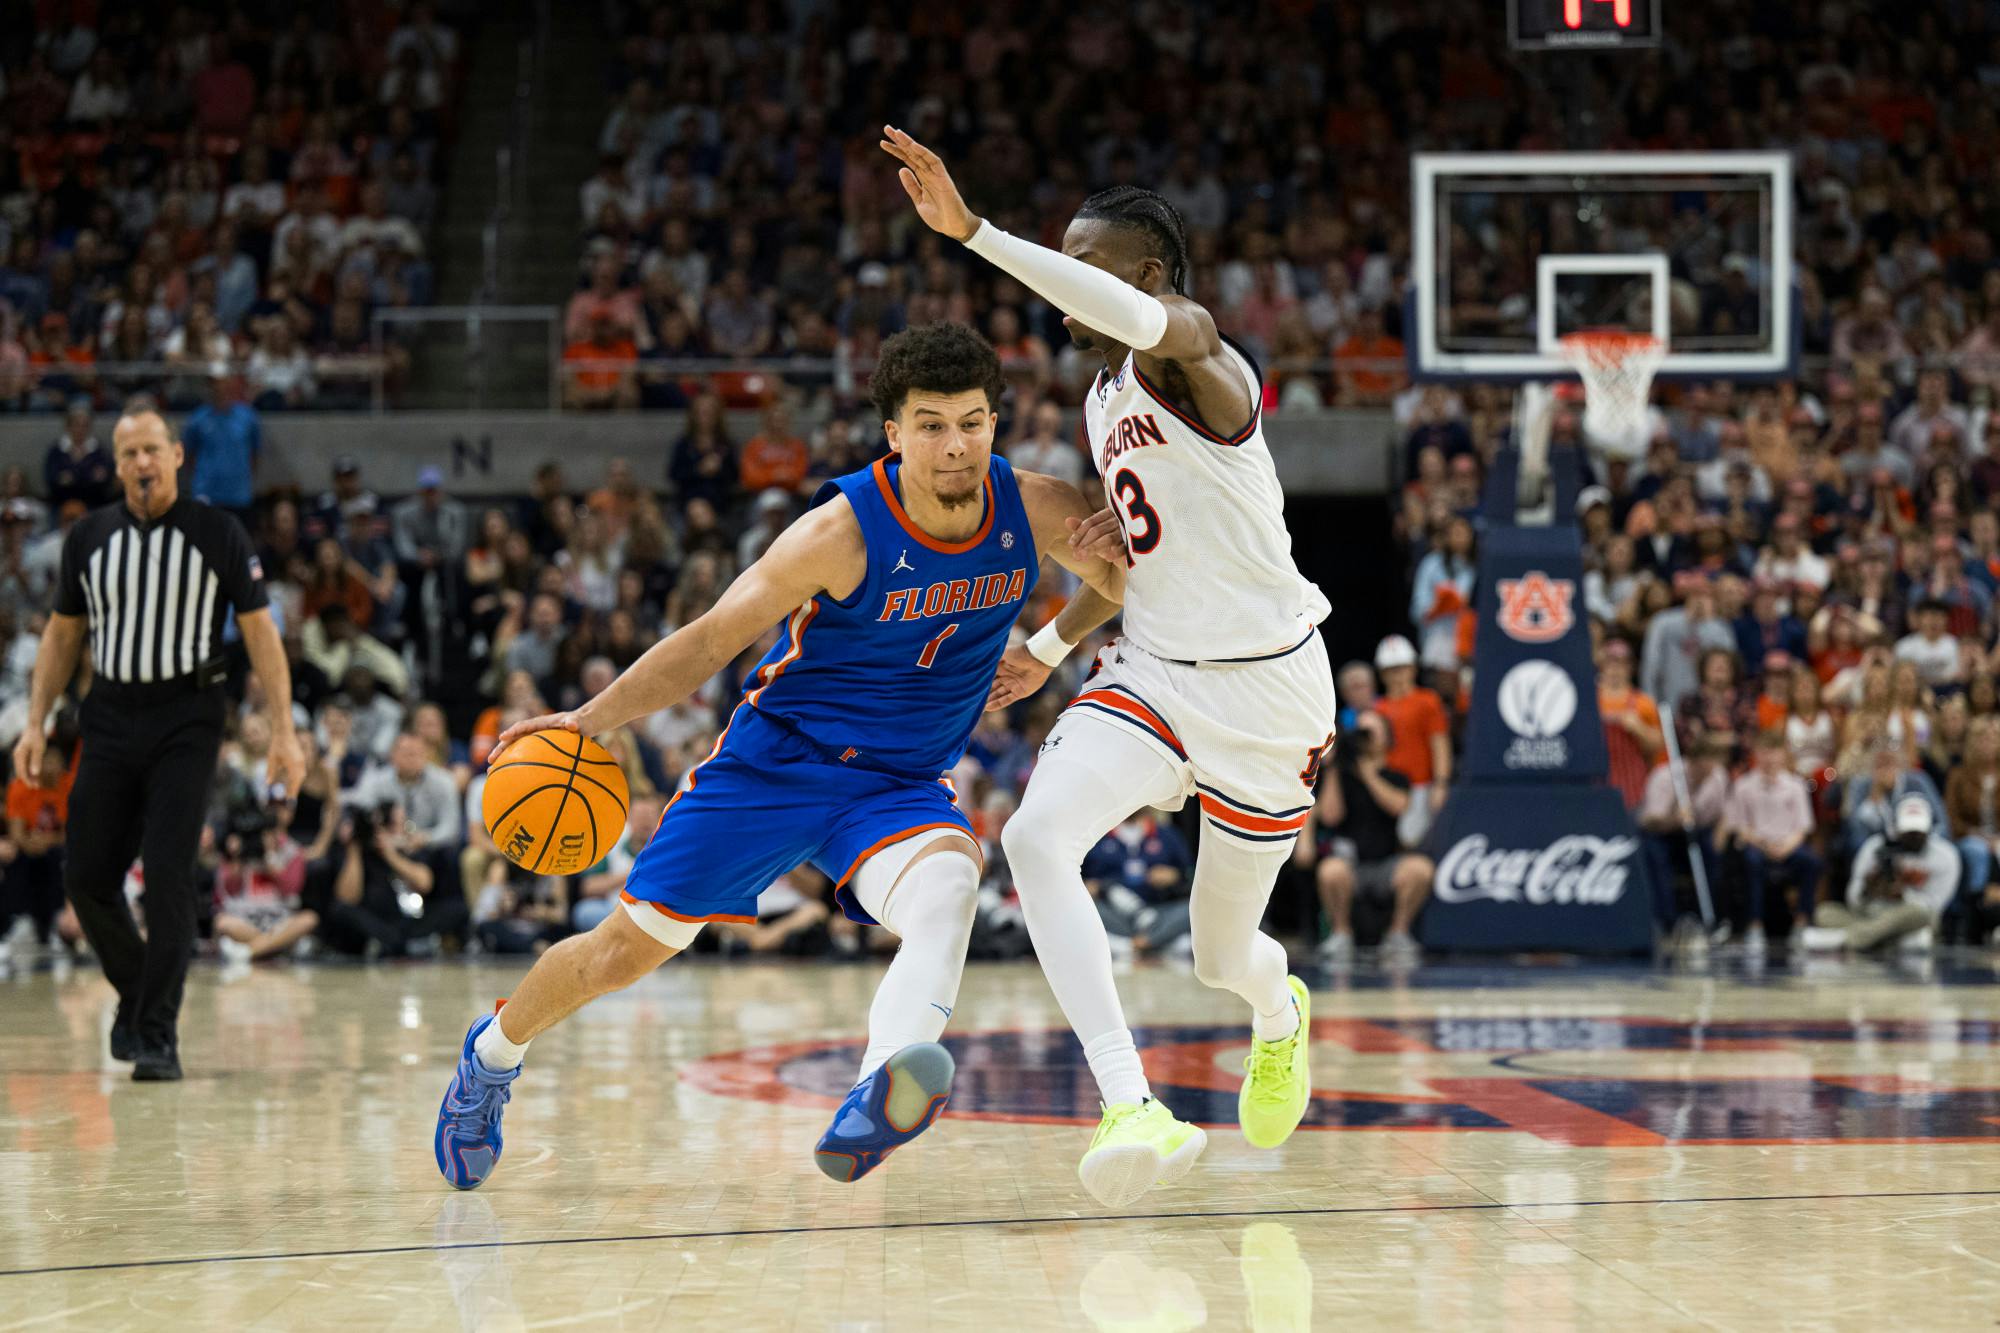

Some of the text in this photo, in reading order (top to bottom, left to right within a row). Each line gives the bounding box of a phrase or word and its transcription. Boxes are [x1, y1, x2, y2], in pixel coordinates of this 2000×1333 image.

[451, 434, 494, 477] N
[876, 568, 1026, 621] FLORIDA
[916, 623, 959, 669] 1
